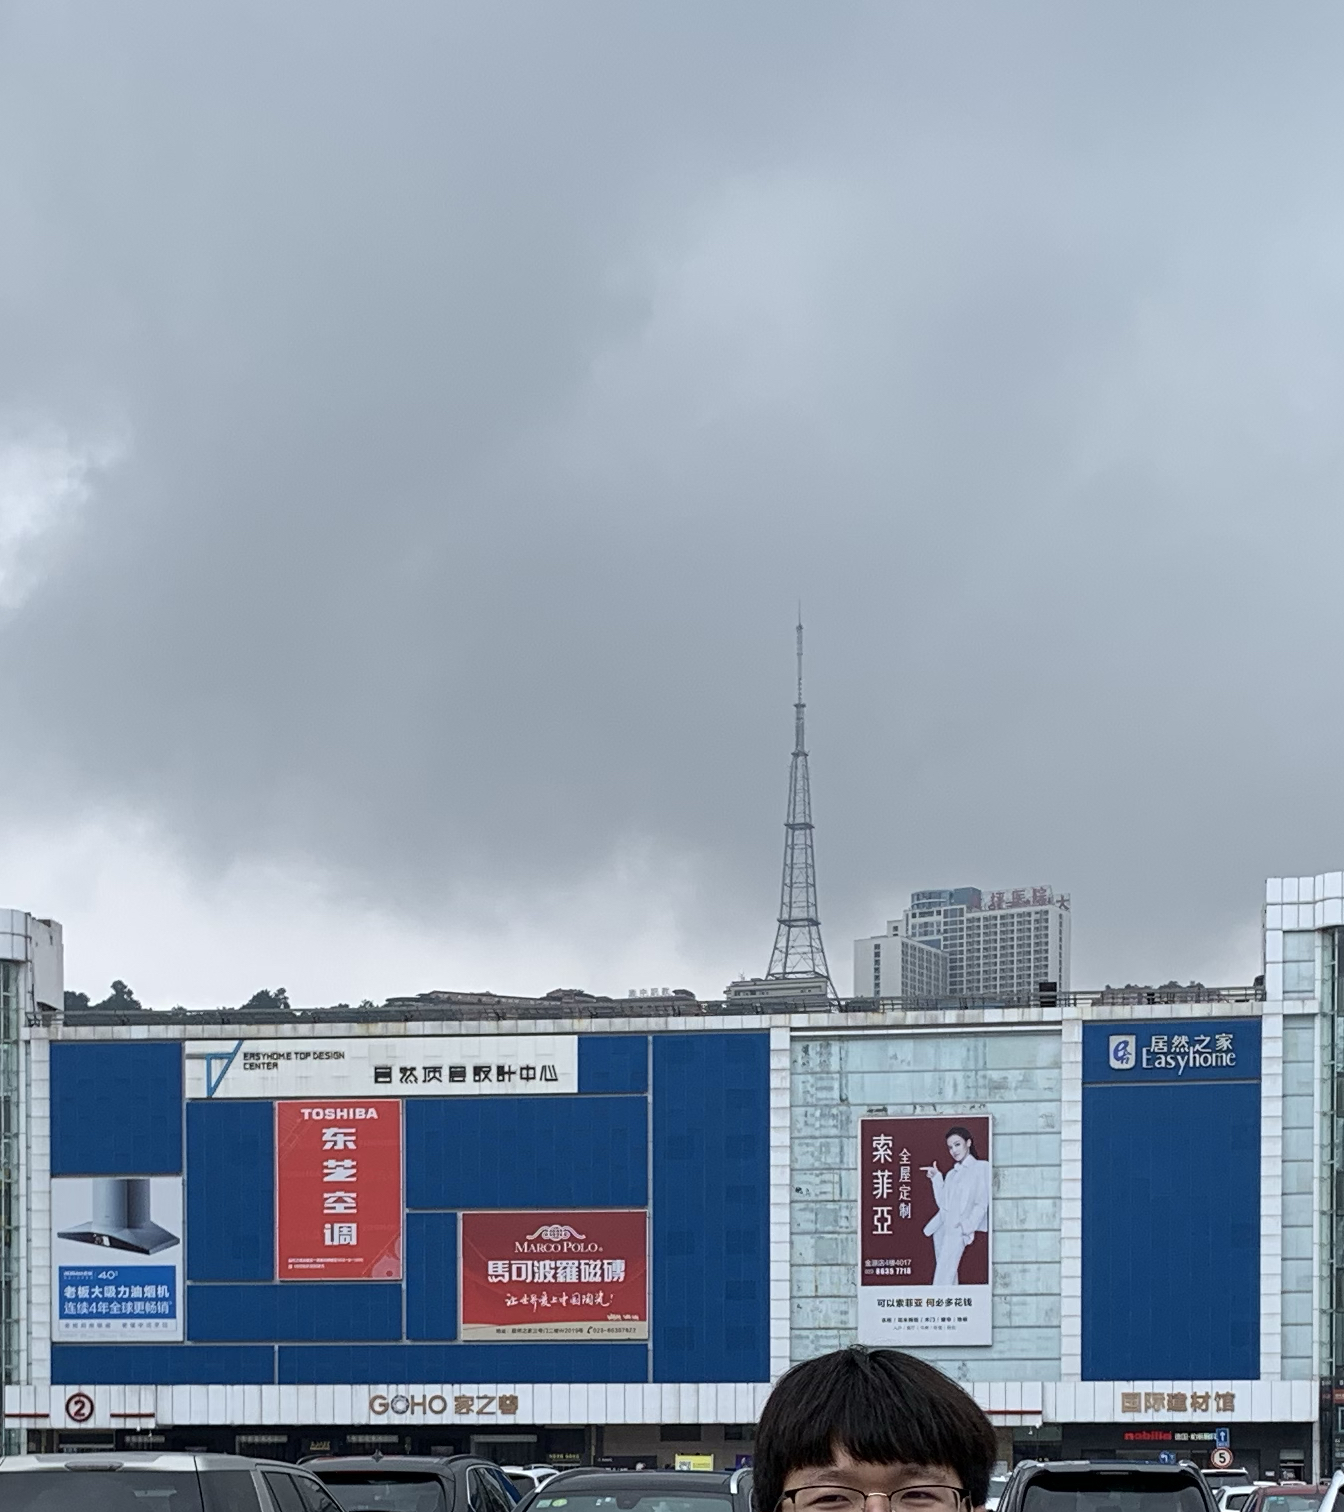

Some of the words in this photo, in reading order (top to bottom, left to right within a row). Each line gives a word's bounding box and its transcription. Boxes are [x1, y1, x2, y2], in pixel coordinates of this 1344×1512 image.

[1150, 1033, 1234, 1053] 居然之家
[312, 1052, 345, 1060] DESIGN
[1142, 1047, 1236, 1075] Easyhome
[243, 1062, 278, 1070] CENTER
[301, 1108, 378, 1120] TOSHIBA
[322, 1127, 357, 1246] 东芝空调
[898, 1148, 911, 1219] 全屋定制
[514, 1242, 560, 1253] MARCO
[563, 1242, 598, 1252] POLO
[63, 1285, 170, 1299] 老板大吸力油烟机
[877, 1298, 923, 1308] 可以索菲亚
[926, 1297, 973, 1307] 何必多花钱
[369, 1394, 447, 1416] GOHO
[1121, 1391, 1236, 1414] 国际建材馆
